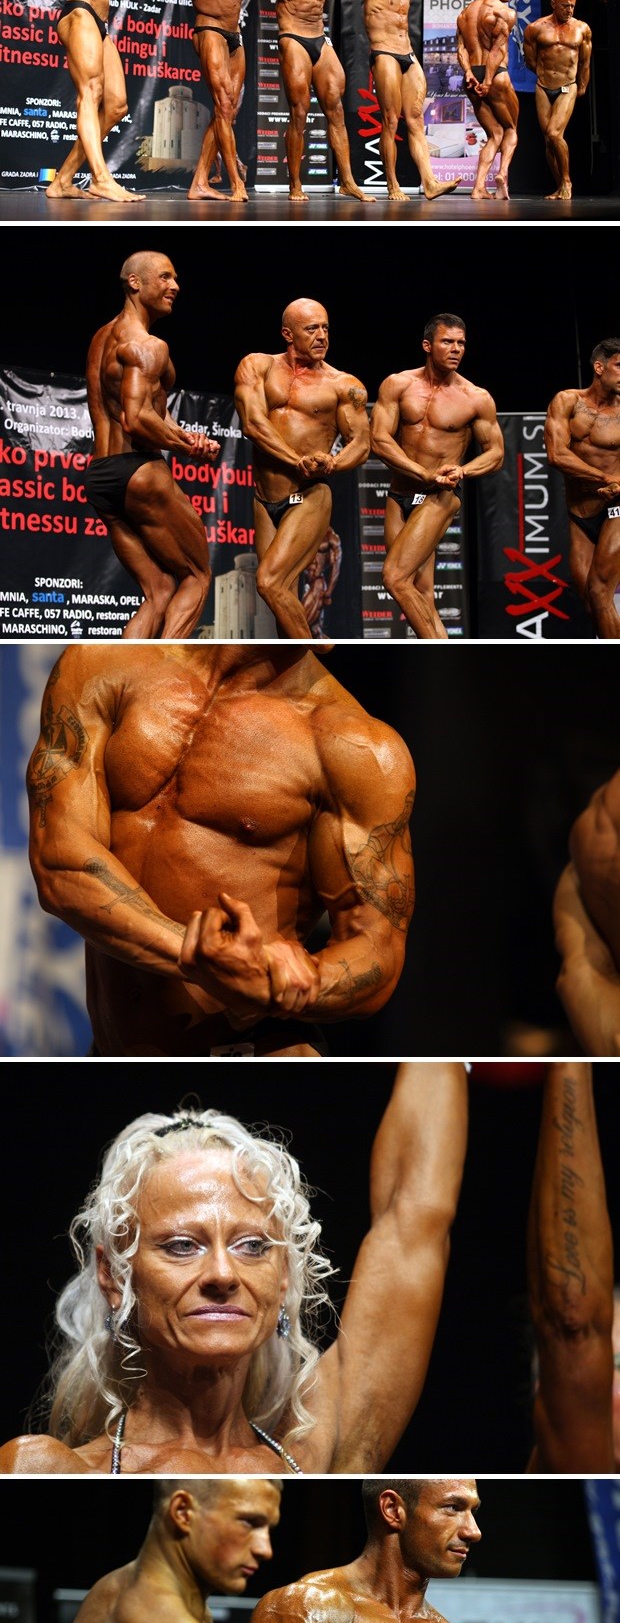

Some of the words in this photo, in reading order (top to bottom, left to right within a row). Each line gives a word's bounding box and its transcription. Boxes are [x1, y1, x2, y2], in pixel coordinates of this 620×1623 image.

[120, 1, 138, 11] HULK
[143, 5, 162, 14] Zadar
[133, 62, 201, 82] muškarce
[26, 97, 61, 107] SPONZORI:
[24, 107, 48, 117] santa
[9, 119, 31, 129] CAFFE,
[45, 122, 68, 131] RADIO,
[1, 130, 49, 141] MARASCHINO,
[7, 400, 46, 417] travnja
[50, 405, 80, 420] 2013.
[4, 419, 69, 438] Organizator:
[179, 420, 210, 437] Zadar,
[212, 422, 242, 438] Široka
[223, 492, 228, 513] i
[609, 508, 620, 517] 41
[2, 509, 77, 535] tnessu
[84, 518, 108, 536] za
[35, 577, 83, 589] SPONZORI:
[32, 592, 64, 603] santa
[72, 594, 118, 607] MARASKA,
[120, 596, 140, 606] OPEL
[12, 608, 42, 620] CAFFE,
[44, 609, 60, 619] 057
[63, 610, 94, 621] RADIO,
[96, 611, 130, 621] restoran
[362, 610, 392, 618] WEIDER
[2, 623, 68, 636] MARASCHINO,
[88, 626, 122, 636] restoran
[561, 1164, 585, 1201] my
[563, 1209, 577, 1227] is
